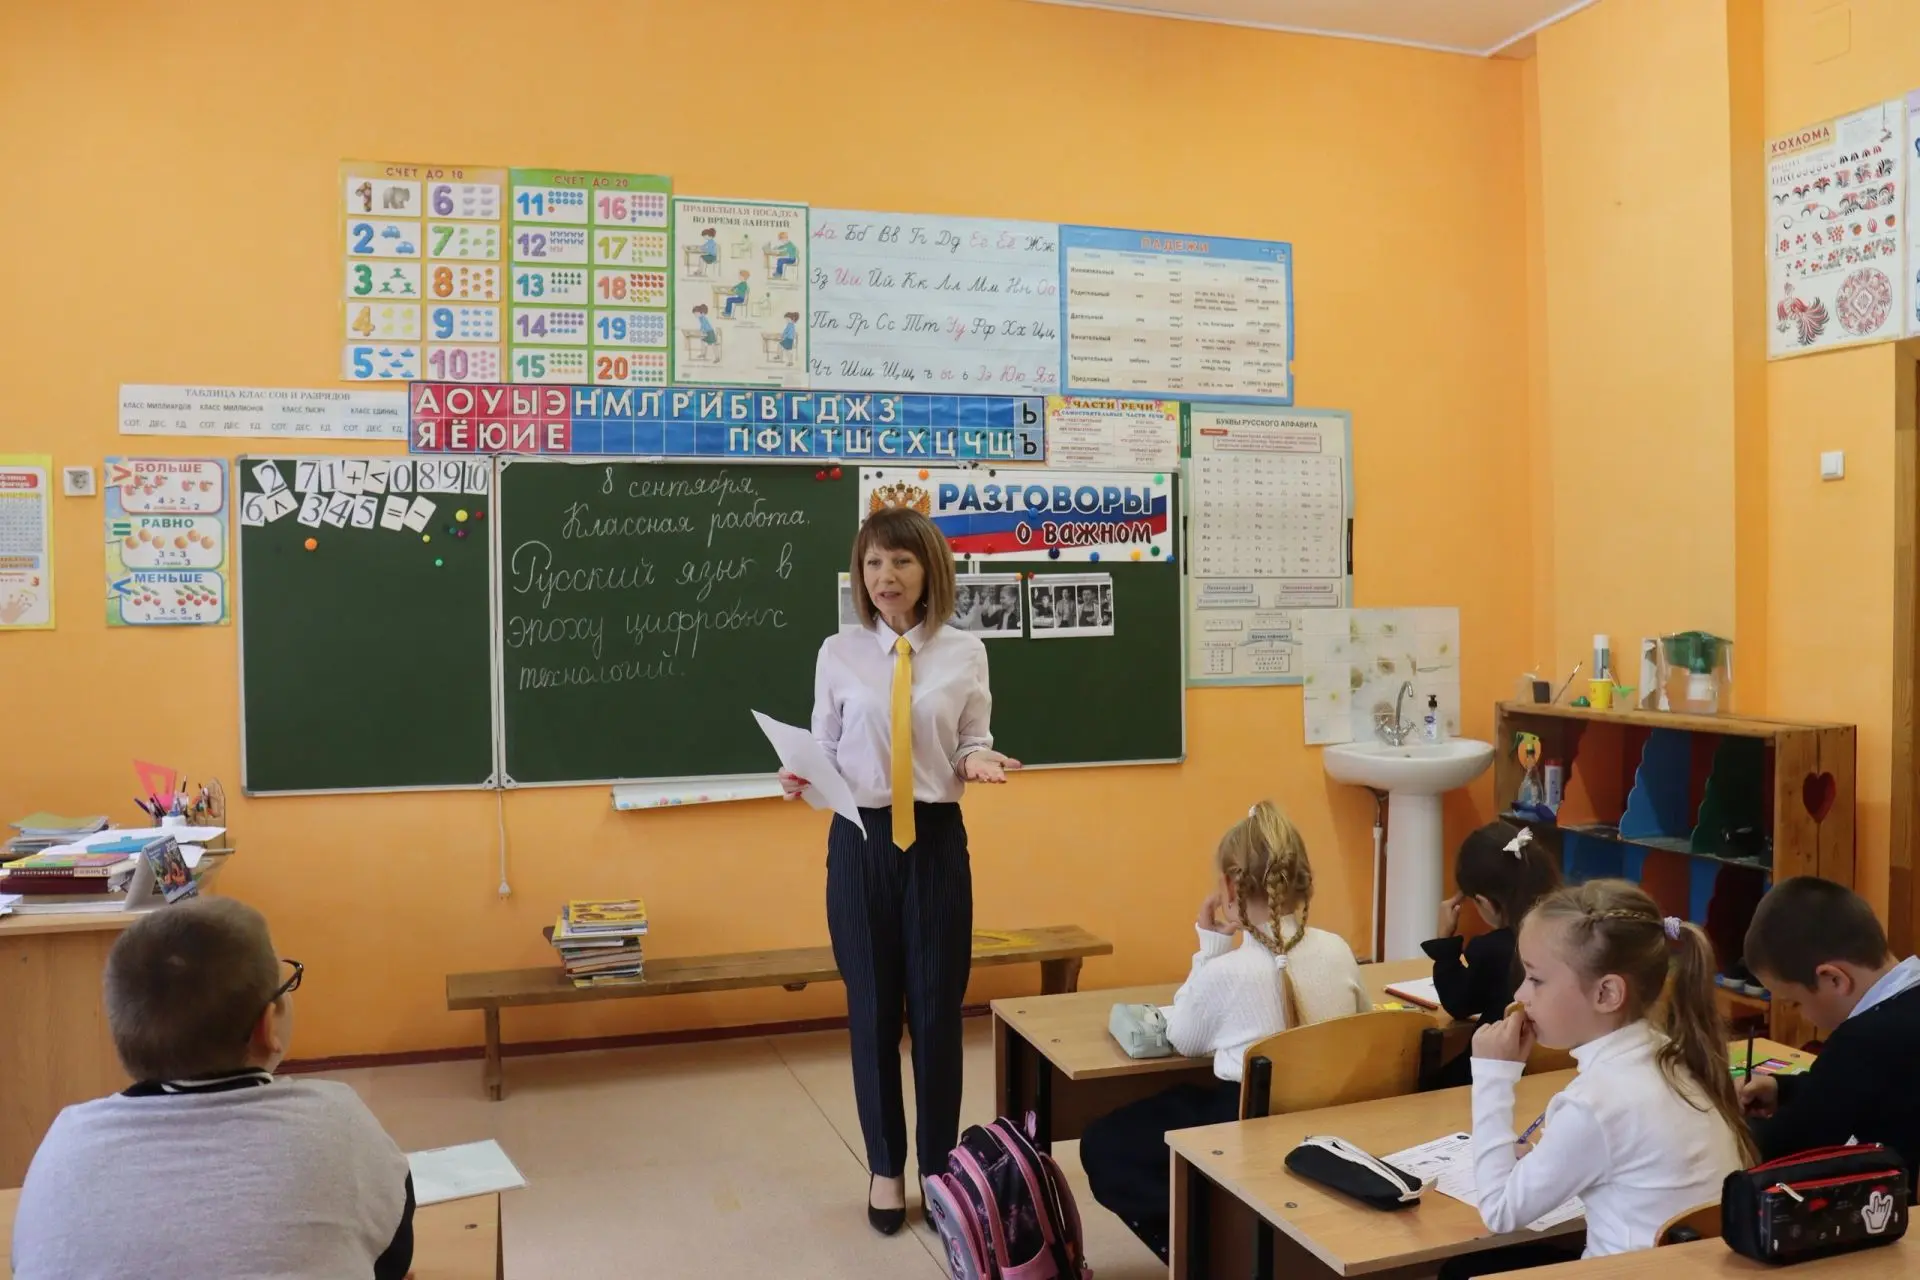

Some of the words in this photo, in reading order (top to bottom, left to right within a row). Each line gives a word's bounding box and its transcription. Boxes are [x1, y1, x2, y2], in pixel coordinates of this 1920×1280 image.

[1771, 127, 1830, 154] ХОХЛОМА
[386, 167, 418, 178] СЧЕТ
[426, 170, 444, 180] ДО
[554, 176, 586, 185] СЧЕТ
[592, 178, 610, 188] ДО
[355, 181, 372, 212] 1
[433, 185, 454, 216] 6
[517, 192, 544, 216] 11
[598, 196, 627, 219] 16
[692, 216, 705, 224] ВО
[708, 217, 740, 226] ВРЕМЯ
[743, 218, 790, 228] ЗАНЯТИЙ
[353, 223, 374, 254] 2
[432, 226, 454, 256] 7
[517, 233, 546, 257] 12
[598, 236, 628, 259] 17
[845, 224, 871, 241] Бб
[878, 225, 901, 243] Вв
[911, 227, 927, 244] Гг
[935, 230, 960, 253] Дд
[1024, 236, 1055, 252] Жж
[1140, 237, 1209, 253] ПАДЕЖИ
[353, 264, 373, 295] 3
[433, 266, 454, 297] 8
[517, 273, 544, 297] 13
[598, 276, 627, 299] 18
[352, 306, 375, 337] 4
[433, 308, 454, 338] 9
[517, 314, 548, 337] 14
[598, 317, 626, 340] 19
[353, 347, 374, 378] 5
[429, 349, 468, 379] 10
[517, 355, 545, 378] 15
[597, 356, 628, 379] 20
[146, 403, 192, 411] МИЛЛИАРДОВ
[185, 388, 236, 400] ТАБЛИЦА
[290, 391, 298, 399] И
[300, 392, 350, 401] РАЗРЯДОВ
[414, 389, 440, 415] А
[446, 389, 473, 414] О
[481, 389, 503, 415] У
[513, 390, 537, 415] Ы
[546, 391, 565, 415] Э
[576, 391, 597, 416] Н
[604, 391, 631, 417] М
[638, 392, 660, 417] Л
[673, 393, 690, 418] Р
[700, 391, 722, 418] Й
[731, 396, 748, 419] Б
[761, 396, 778, 420] В
[791, 397, 809, 421] Г
[816, 397, 839, 424] Д
[845, 398, 871, 421] Ж
[879, 398, 895, 423] З
[1023, 403, 1037, 425] Ь
[1072, 400, 1115, 409] ЧАСТИ
[1121, 402, 1153, 410] РЕЧИ
[350, 407, 371, 415] КЛАСС
[372, 408, 398, 416] ЕДИНИЦ
[1242, 419, 1279, 428] РУССКОГО
[1281, 420, 1318, 428] АЛФАВИТА
[416, 423, 435, 448] Я
[451, 419, 469, 448] Ё
[479, 423, 507, 449] Ю
[513, 424, 535, 449] И
[548, 424, 564, 449] Е
[730, 427, 748, 451] П
[756, 428, 781, 452] Ф
[790, 428, 809, 453] К
[821, 428, 840, 453] Т
[846, 429, 871, 453] Ш
[878, 429, 897, 454] С
[907, 430, 927, 454] Х
[936, 431, 956, 457] Ц
[964, 431, 981, 454] Ч
[989, 432, 1013, 457] Щ
[1019, 434, 1037, 454] Ъ
[134, 463, 202, 473] БОЛЬШЕ
[260, 464, 286, 493] 2
[300, 462, 317, 489] 7
[327, 463, 336, 490] 1
[393, 464, 411, 491] 0
[419, 462, 435, 489] 8
[464, 464, 486, 491] 10
[602, 466, 613, 494] 8
[302, 496, 323, 523] 3
[329, 498, 350, 524] 4
[355, 498, 375, 525] 5
[938, 482, 1152, 515] РАЗГОВОРЫ
[141, 518, 194, 528] РАВНО
[562, 501, 695, 540] Классная
[134, 573, 203, 583] МЕНЬШЕ
[512, 540, 655, 609] Русский
[675, 557, 757, 601] язык
[507, 615, 603, 660] эпоху
[626, 599, 788, 659] цифровых
